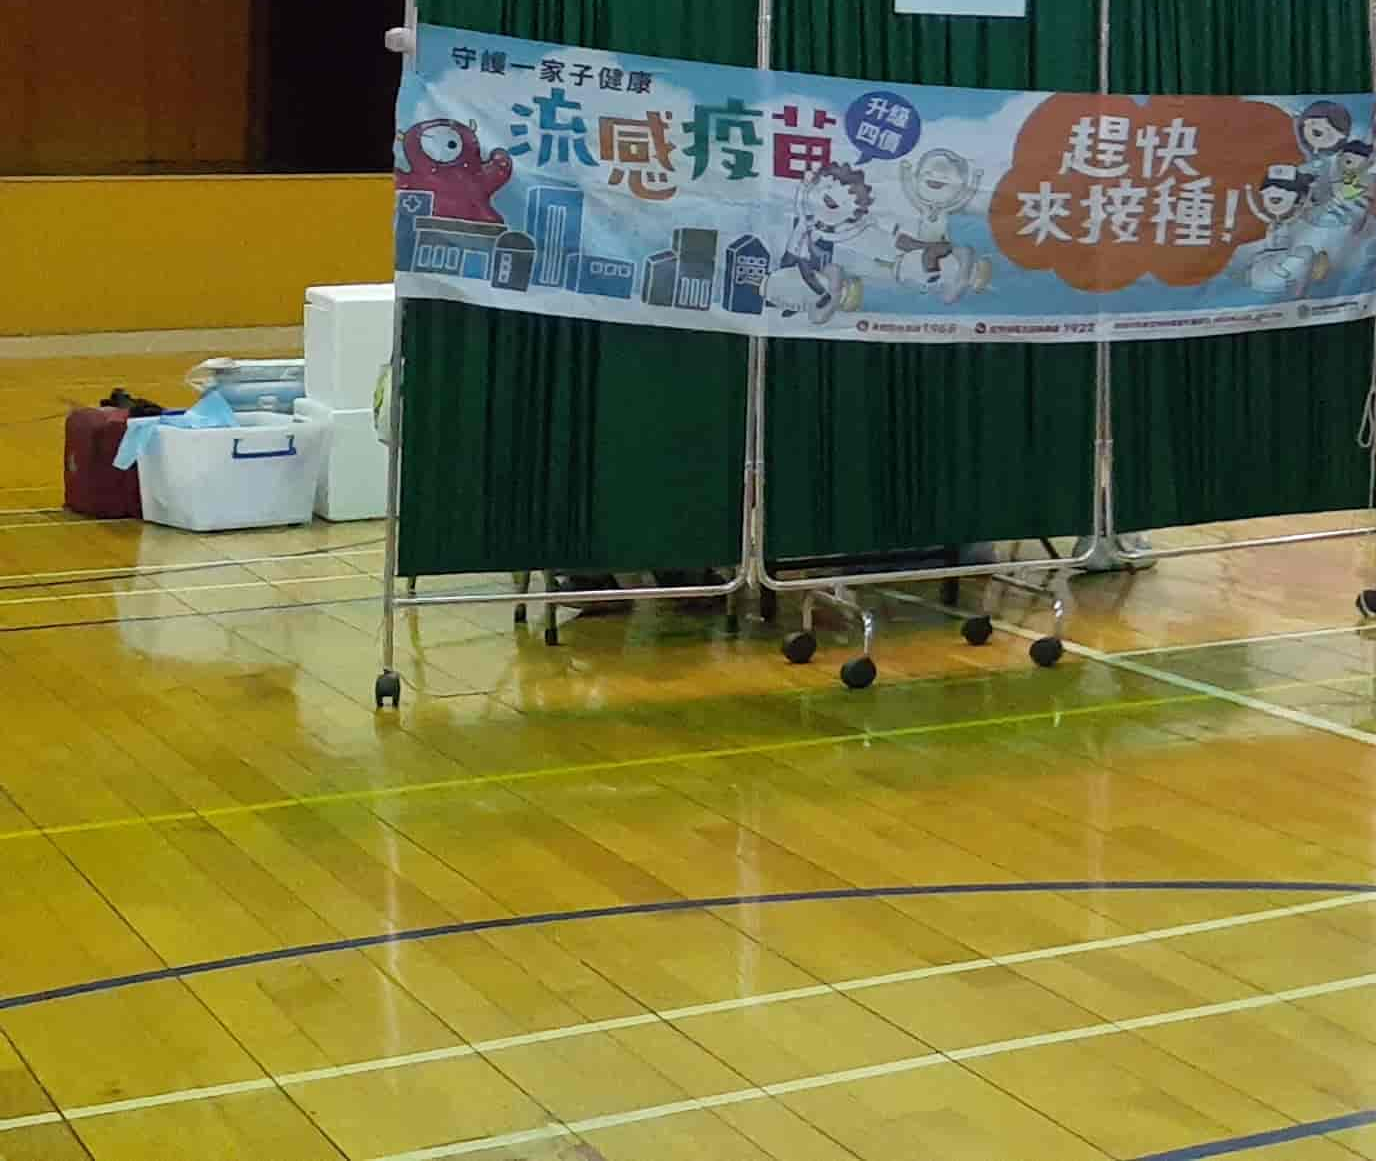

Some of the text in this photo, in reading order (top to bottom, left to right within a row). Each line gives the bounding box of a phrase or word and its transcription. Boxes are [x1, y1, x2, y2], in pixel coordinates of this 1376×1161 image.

[451, 46, 652, 95] 守護一家子健康
[508, 87, 837, 201] 流感疫苗
[1057, 113, 1200, 180] 趕快
